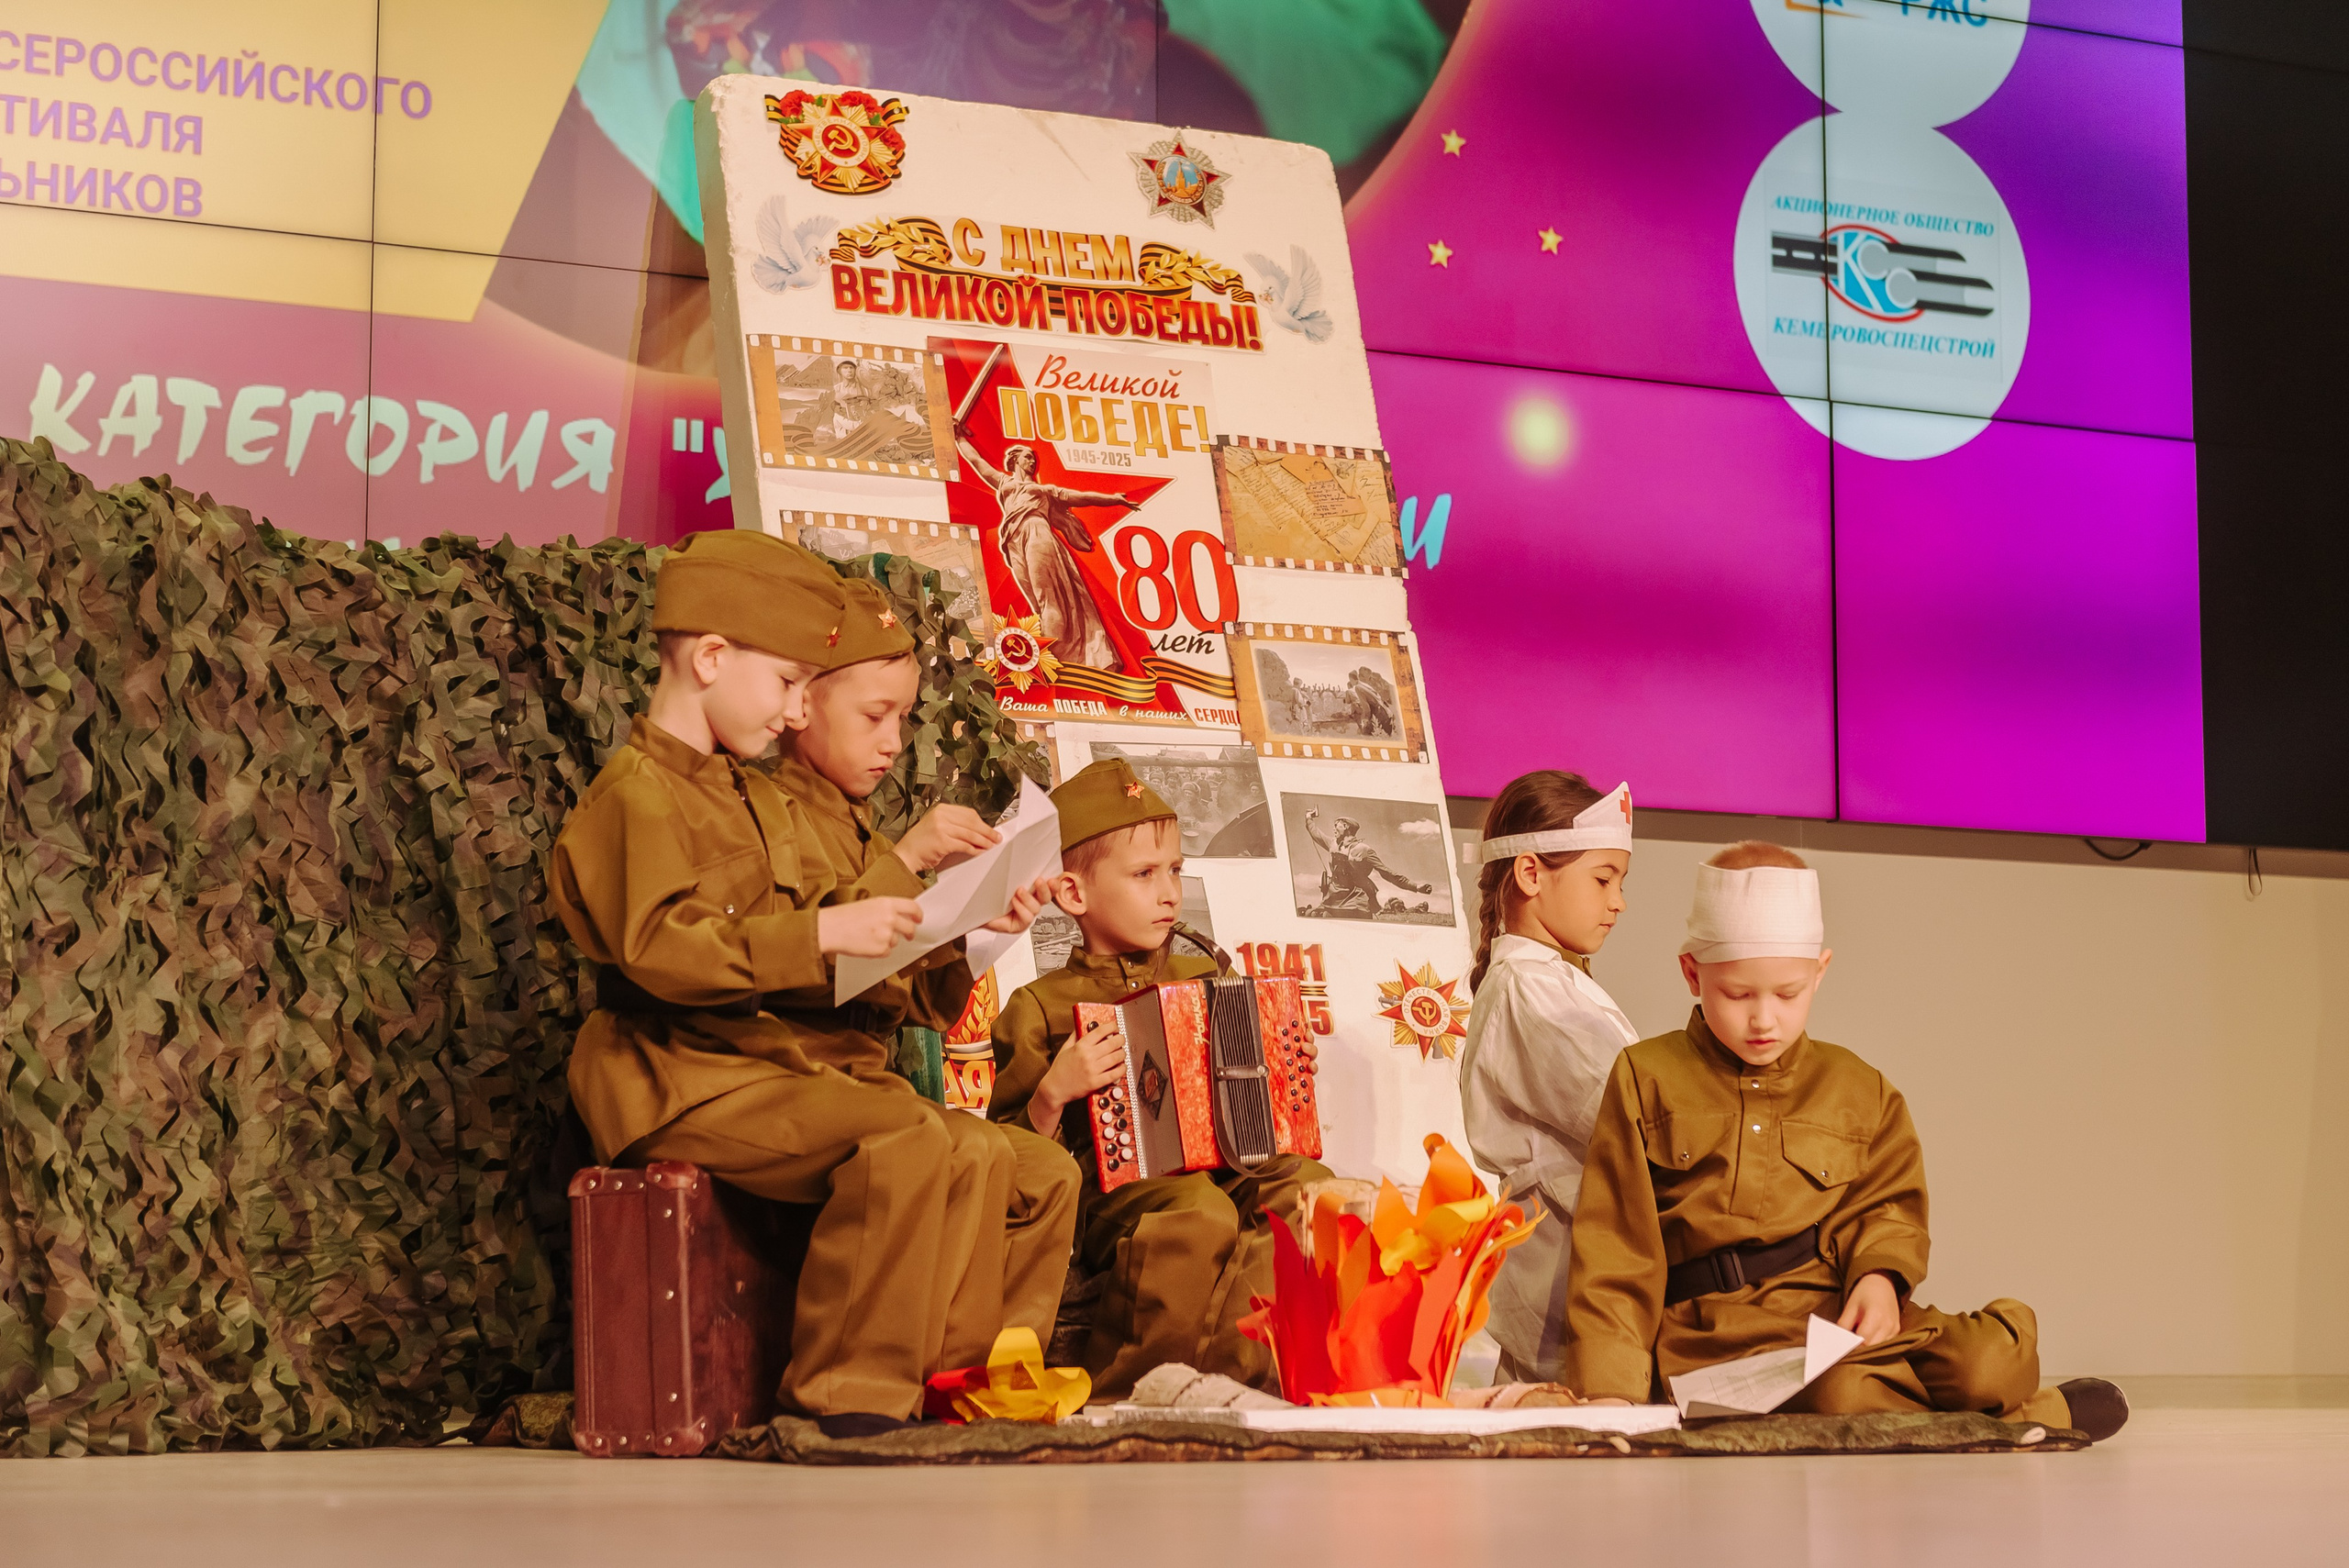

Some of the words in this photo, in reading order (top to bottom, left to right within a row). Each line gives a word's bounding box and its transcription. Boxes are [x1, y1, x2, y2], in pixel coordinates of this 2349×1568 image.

[0, 94, 204, 156] ТИВАЛЯ
[1771, 195, 1900, 225] АКЦИОНЕРНОЕ
[1903, 212, 1995, 237] ОБЩЕСТВО
[952, 217, 985, 267] С
[1000, 224, 1137, 283] ДНЕМ
[830, 262, 1053, 332] ВЕЛИКОЙ
[1061, 287, 1264, 352] ПОБЕДЫ!
[1773, 316, 1997, 359] КЕМЕРОВОСПЕЦСТРОЙ
[1035, 353, 1183, 399] Великой
[28, 362, 616, 494] КАТЕГОРИЯ
[998, 387, 1211, 459] ПОБЕДЕ!
[1065, 448, 1132, 468] 1945-2025
[1113, 526, 1240, 634] 80
[1149, 629, 1215, 654] лет
[999, 695, 1049, 713] Ваша
[1053, 698, 1108, 717] ПОБЕДА
[1119, 705, 1129, 717] в
[1135, 708, 1189, 721] наших
[1236, 942, 1327, 982] 1941
